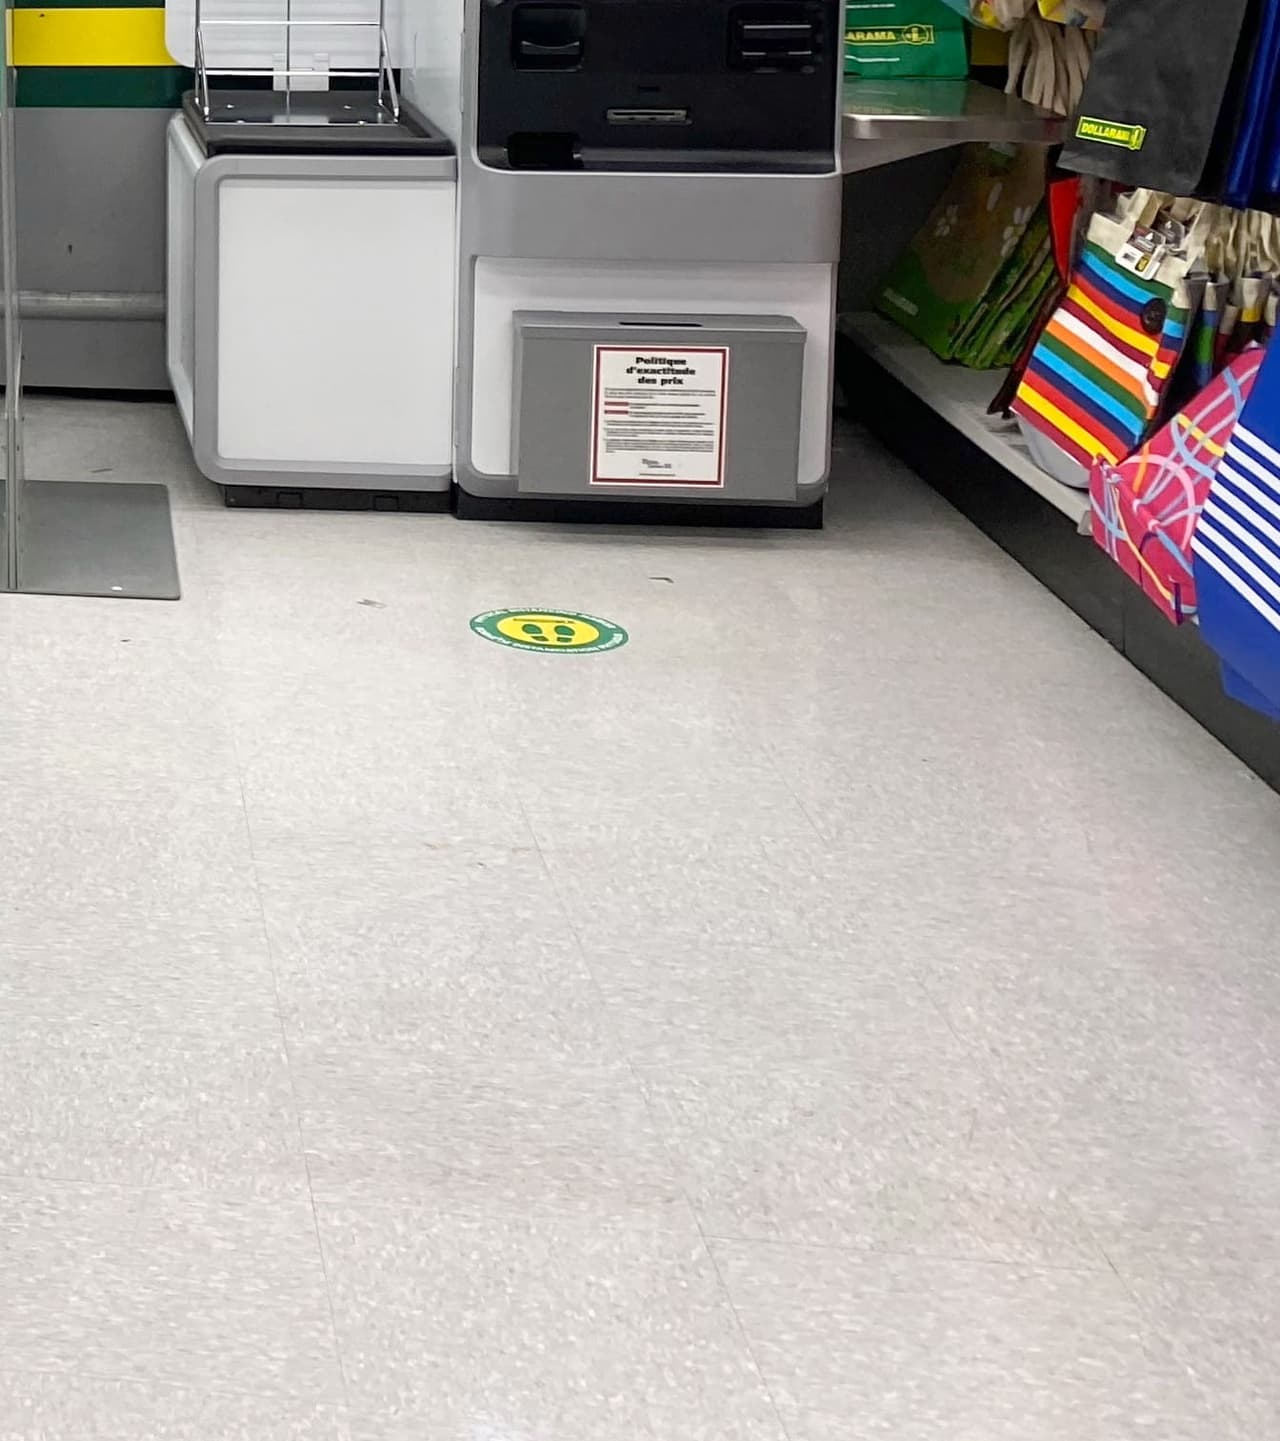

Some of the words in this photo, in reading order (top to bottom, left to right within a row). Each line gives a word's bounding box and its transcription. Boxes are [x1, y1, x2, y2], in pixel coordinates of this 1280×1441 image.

[845, 31, 896, 41] ARAMA
[636, 357, 686, 366] Politique
[661, 377, 684, 386] prix
